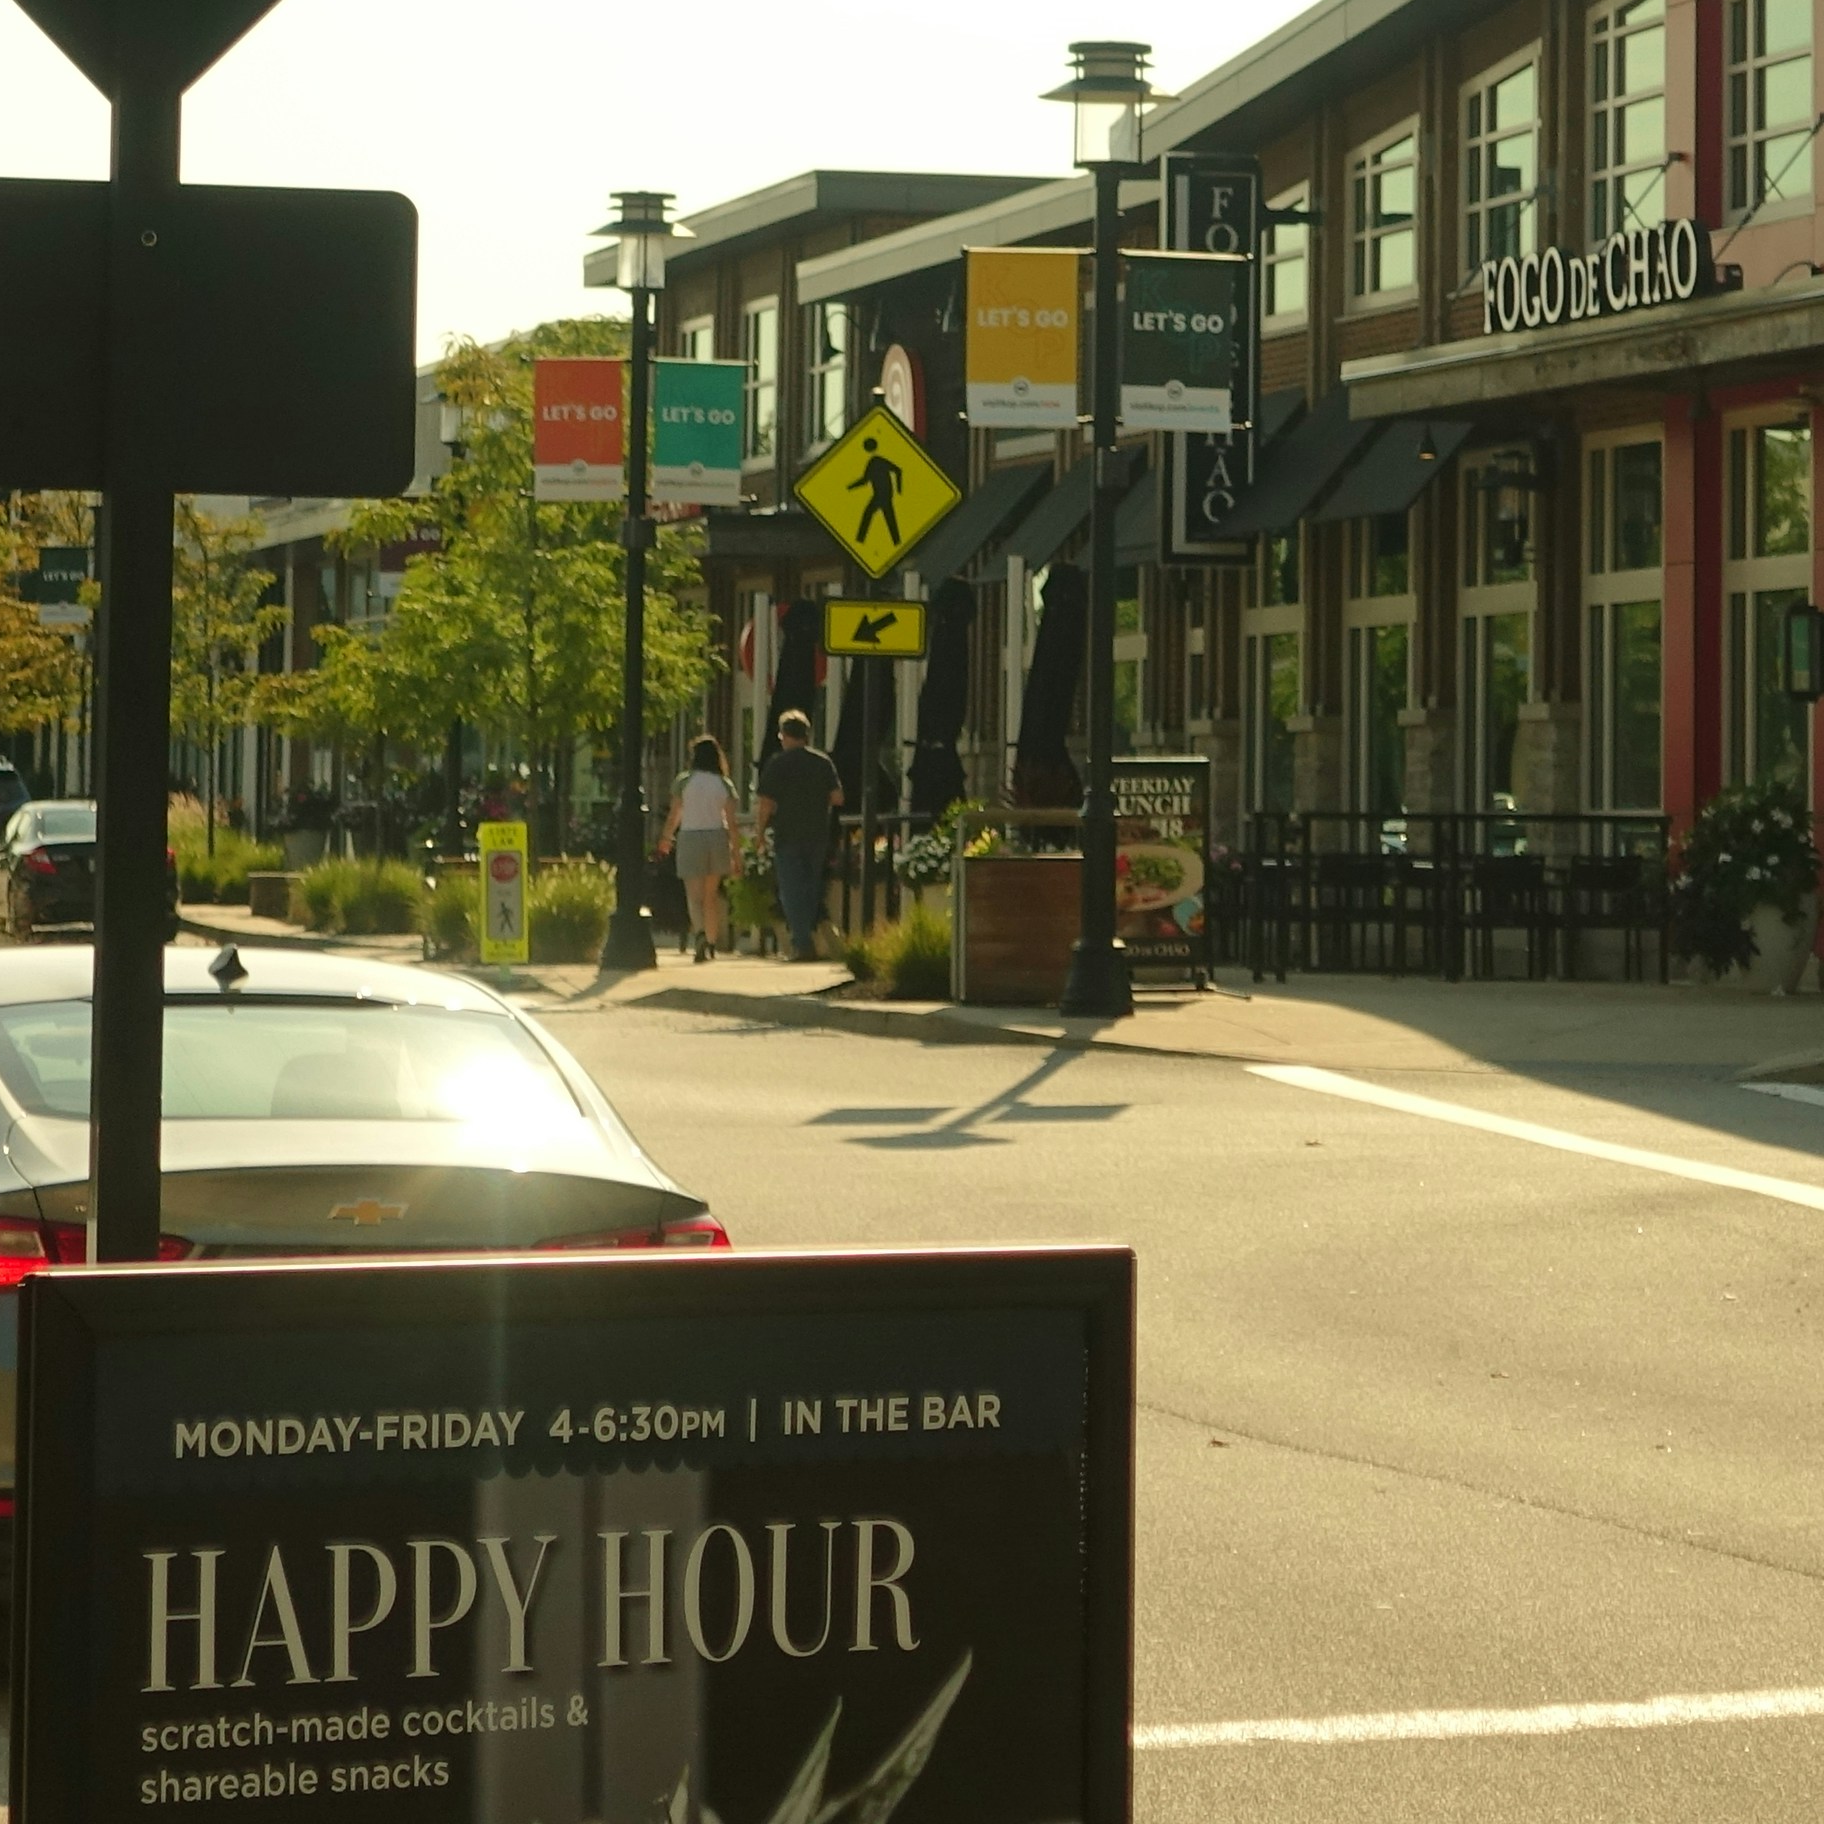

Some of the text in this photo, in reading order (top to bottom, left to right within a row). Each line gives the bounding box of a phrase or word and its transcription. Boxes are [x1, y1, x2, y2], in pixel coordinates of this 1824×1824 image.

[1482, 246, 1564, 334] FOGO
[1569, 253, 1600, 319] DE
[978, 305, 1068, 327] LET'S GO
[1133, 309, 1224, 333] LET'S GO
[542, 404, 617, 422] LET'S GO
[662, 406, 736, 425] LET'S GO
[1114, 795, 1191, 816] UNCH
[176, 1411, 524, 1458] MONDAY-FRIDAY
[549, 1405, 725, 1444] 4-6:30PM
[783, 1400, 821, 1435] IN
[836, 1397, 909, 1433] THE
[922, 1394, 1001, 1430] BAR
[141, 1519, 921, 1692] HAPPY HOUR
[141, 1693, 589, 1752] scratch-made cocktails &
[141, 1754, 450, 1804] shareable snacks
